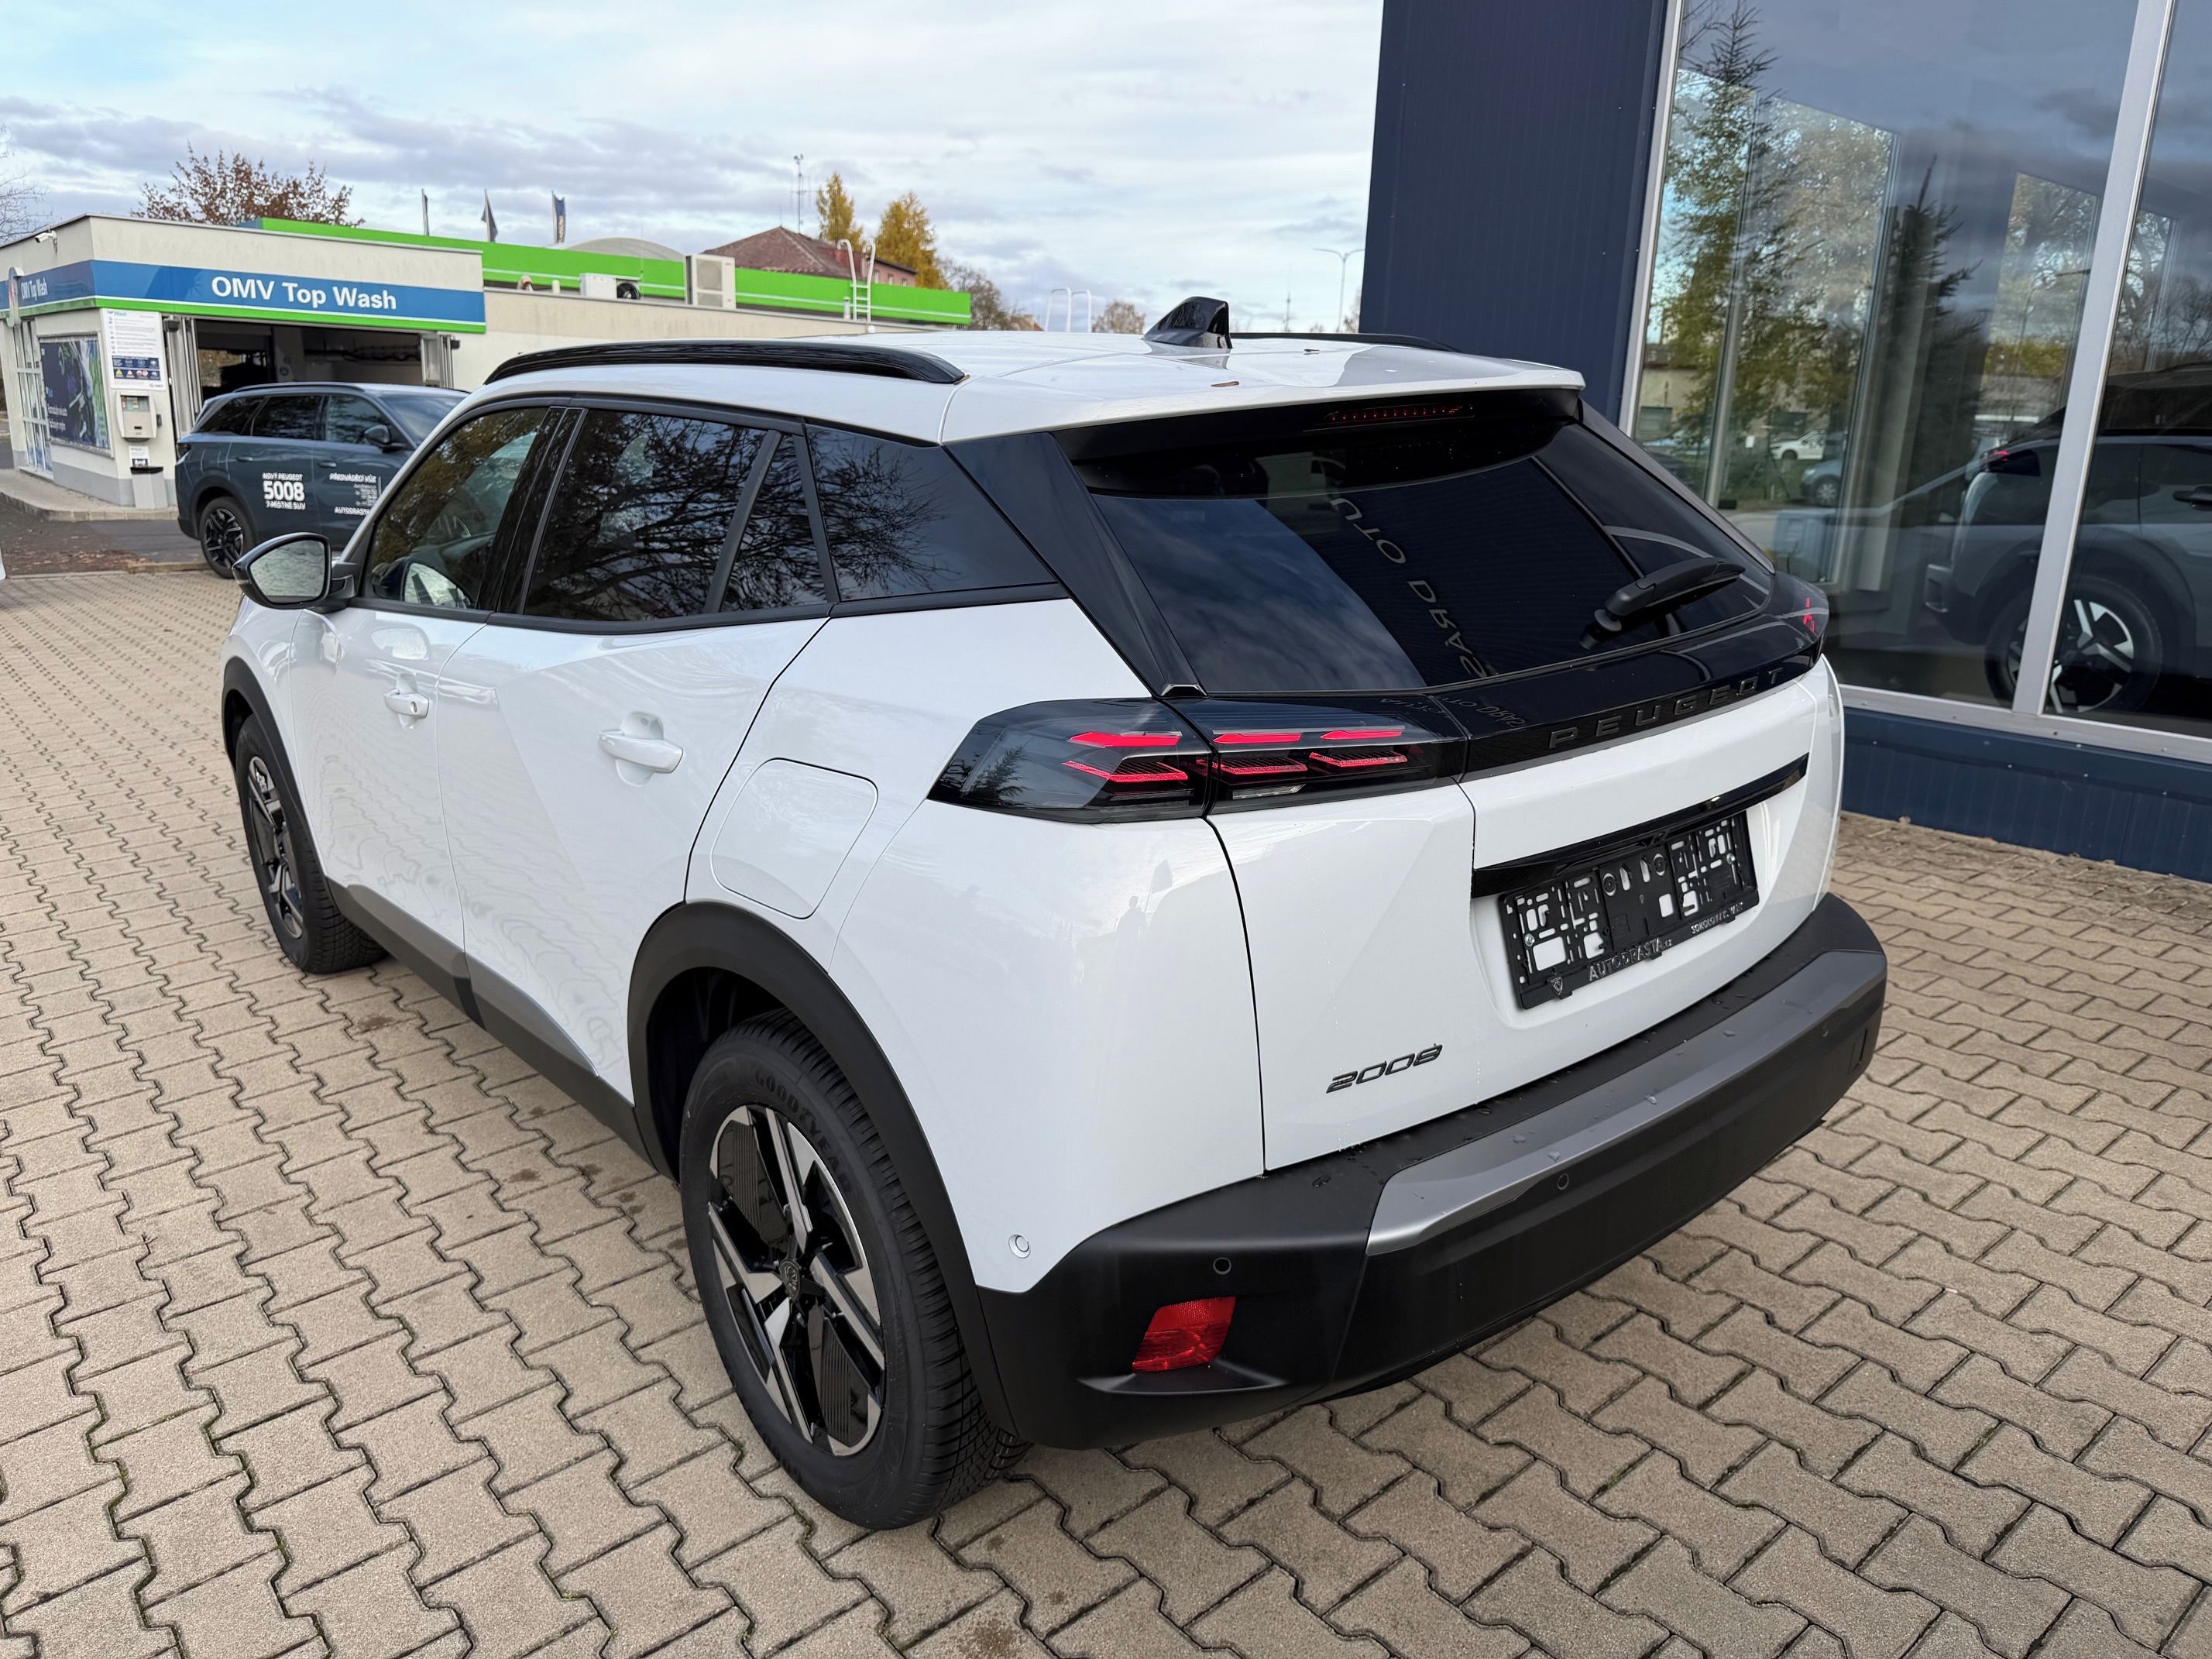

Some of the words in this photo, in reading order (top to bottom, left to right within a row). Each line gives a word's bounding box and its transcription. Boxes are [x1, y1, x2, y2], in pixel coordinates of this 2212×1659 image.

[21, 281, 30, 300] OMV
[36, 277, 48, 297] Wash
[211, 276, 274, 300] OMV
[282, 282, 327, 308] Top
[332, 286, 397, 310] Wash
[278, 472, 303, 481] PEUGEOT
[263, 480, 305, 502] 5008
[1549, 667, 1783, 749] PEUGEOT
[1326, 1044, 1443, 1094] 2008
